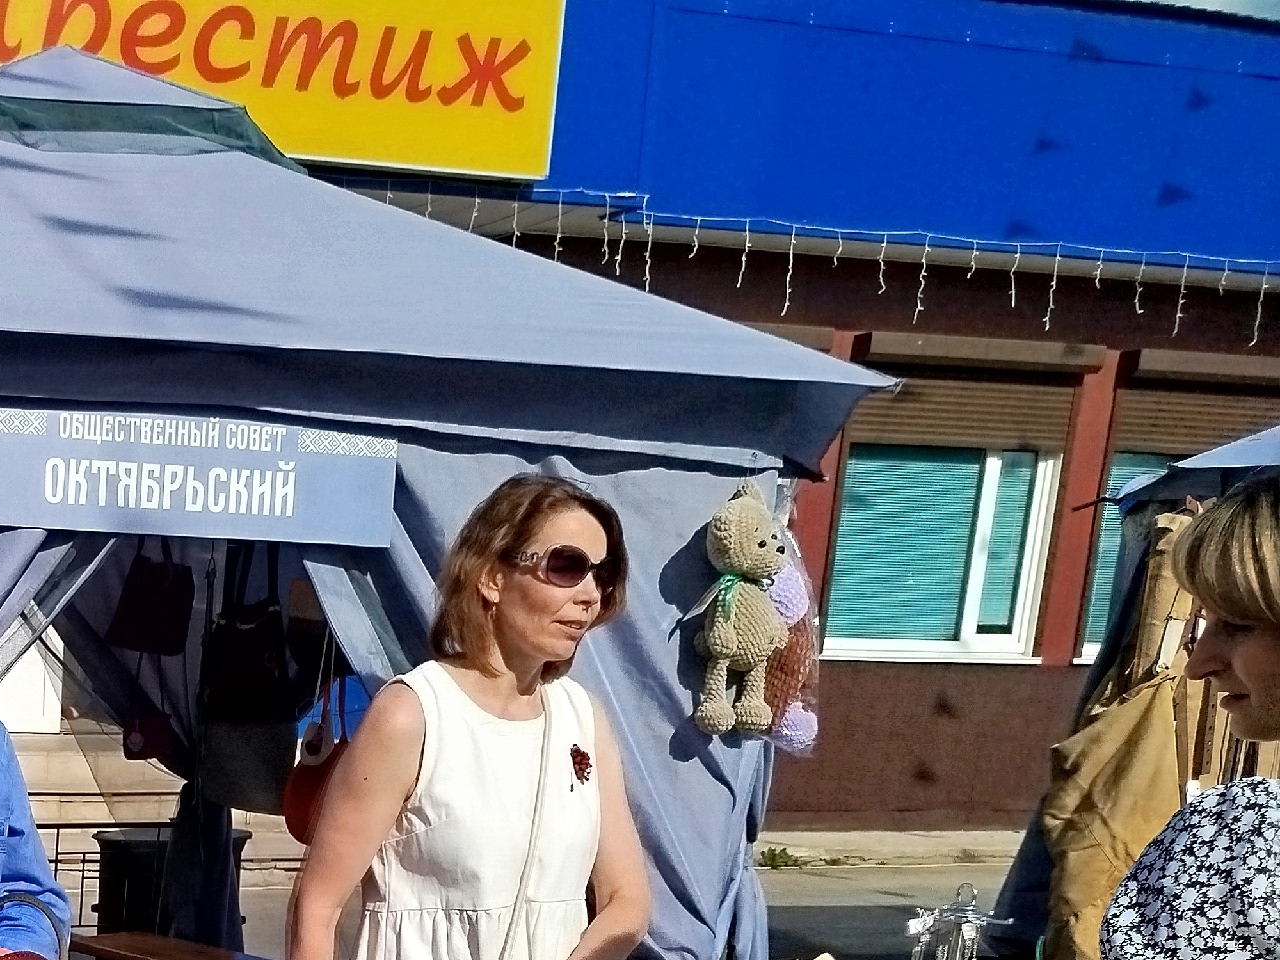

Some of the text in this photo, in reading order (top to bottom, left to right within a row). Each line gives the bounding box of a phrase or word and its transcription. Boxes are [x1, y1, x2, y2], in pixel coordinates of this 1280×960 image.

[59, 412, 287, 452] ОБЩЕСТВЕННЫЙ СОВЕТ
[44, 457, 297, 517] ОКТЯБРЬСКИЙ
